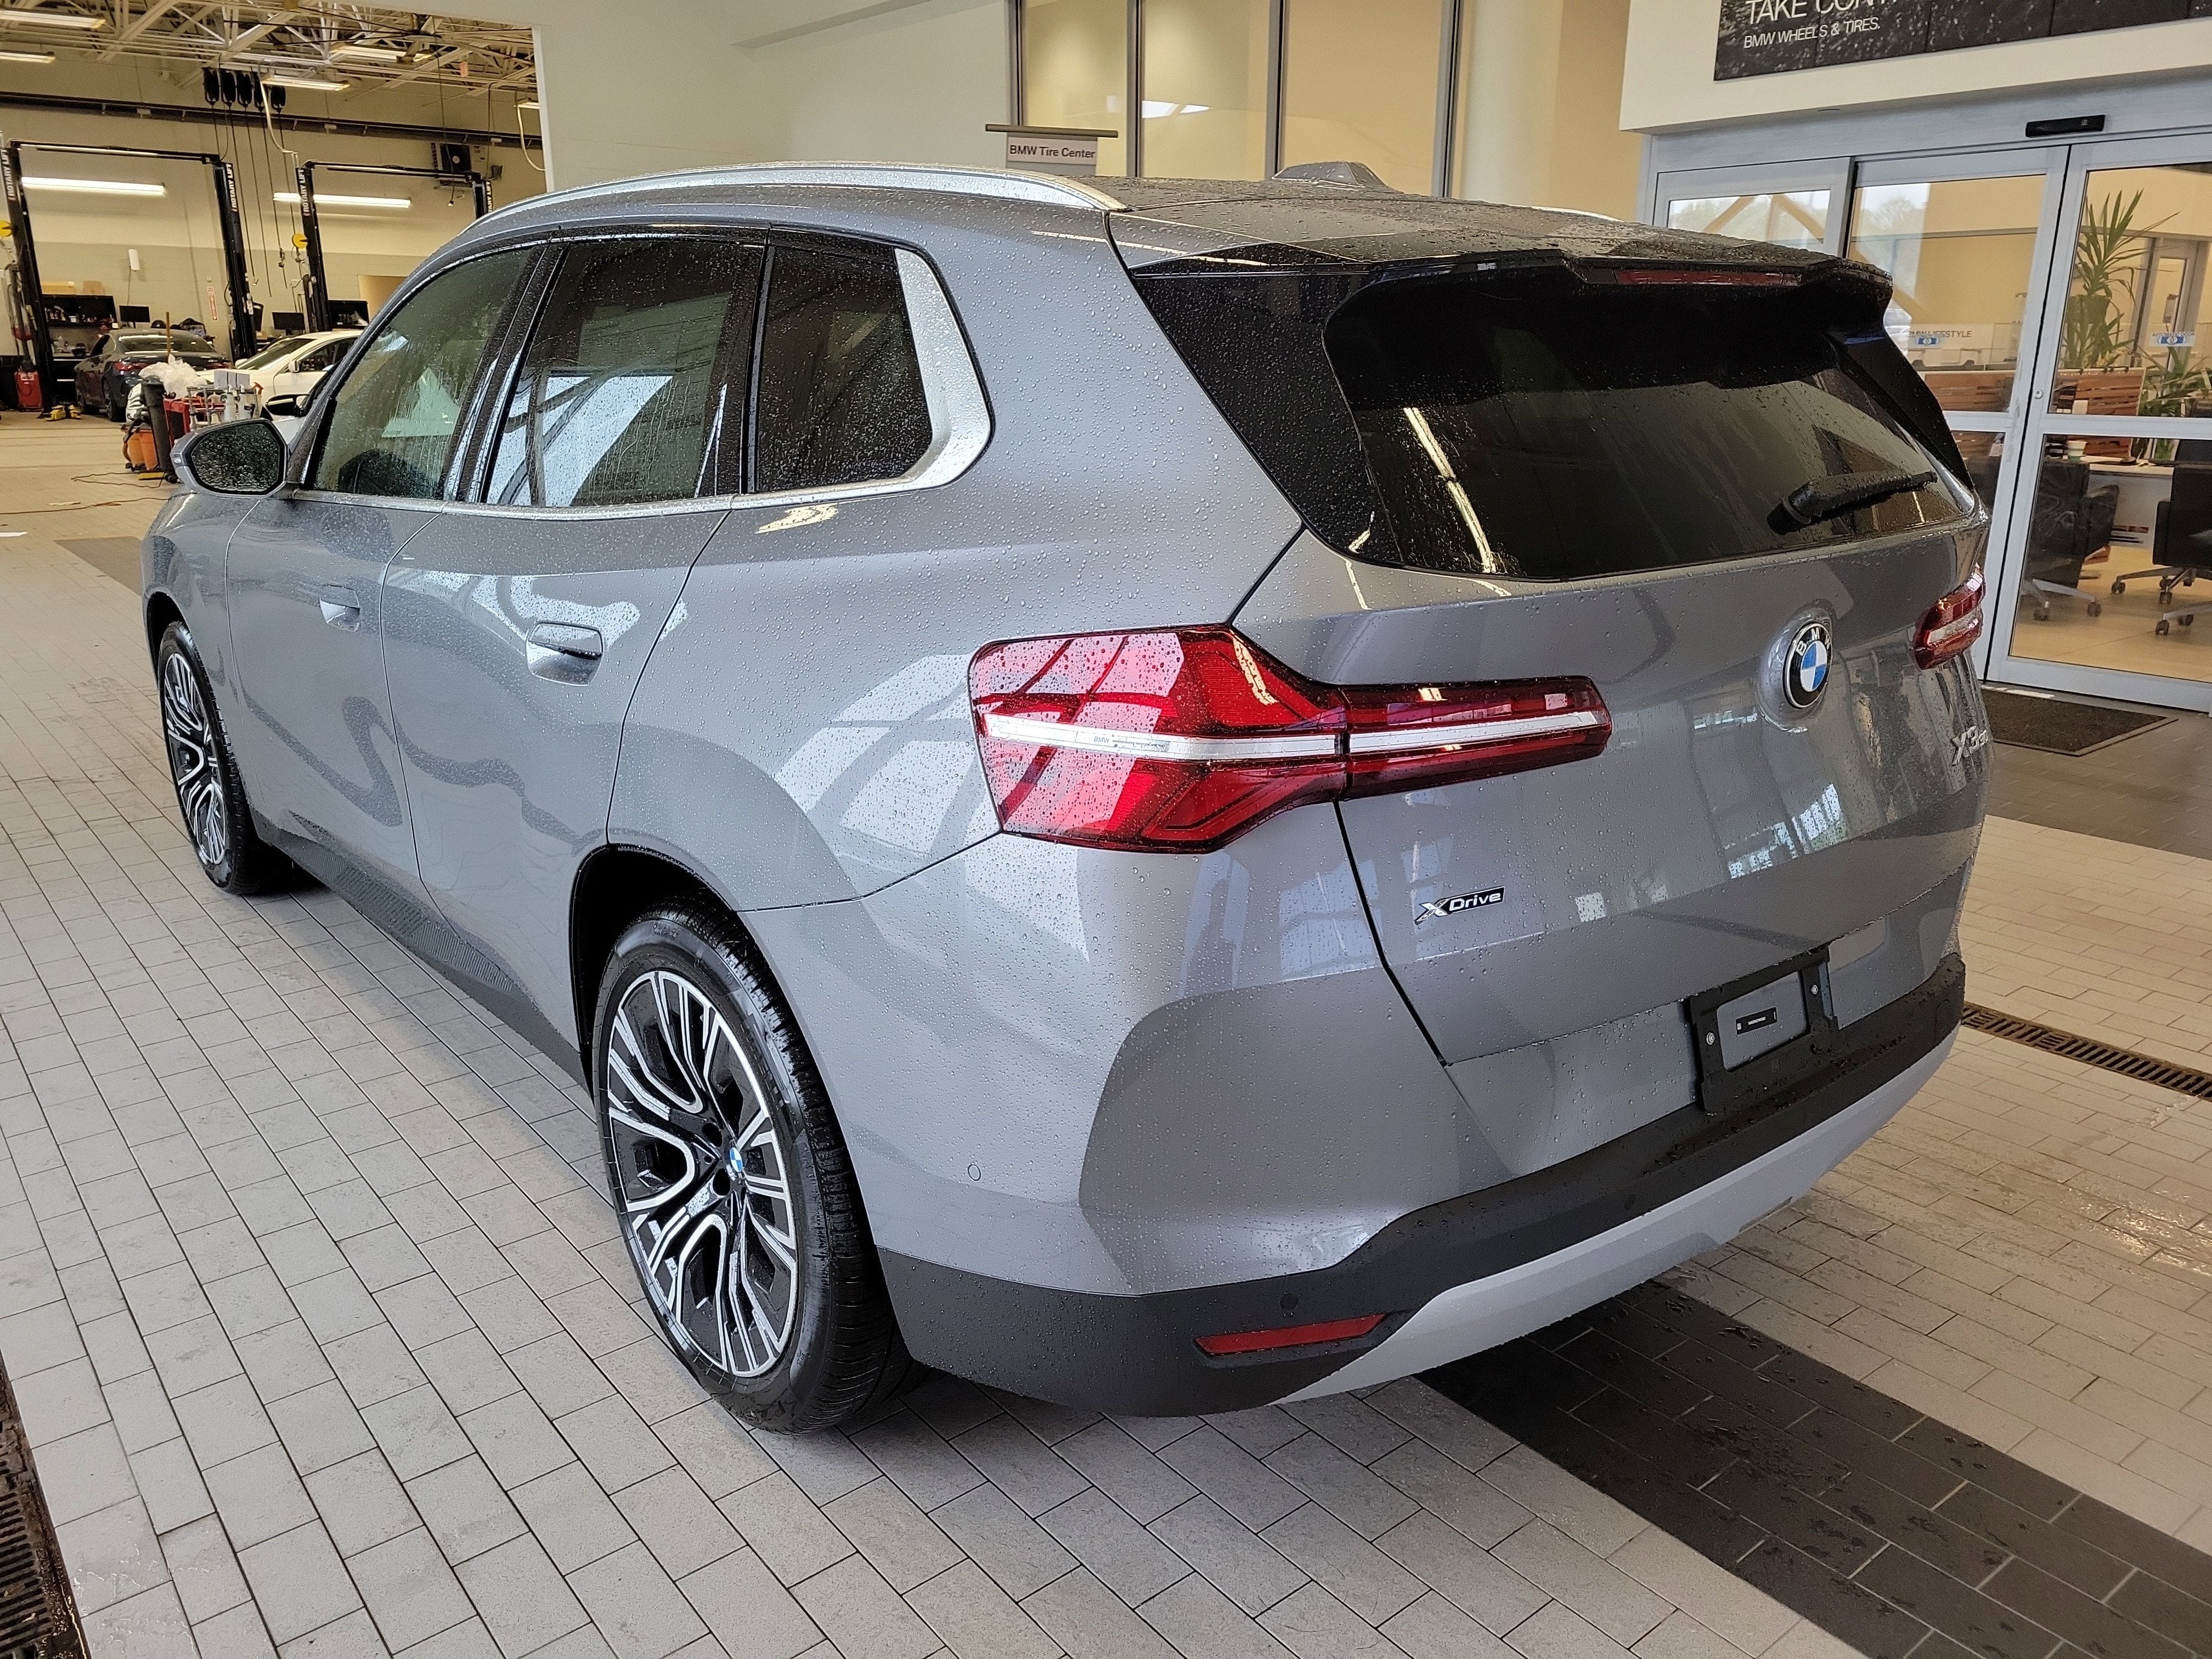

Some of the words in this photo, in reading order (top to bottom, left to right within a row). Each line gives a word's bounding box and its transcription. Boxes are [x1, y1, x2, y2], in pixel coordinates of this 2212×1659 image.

[1746, 0, 1807, 24] TAKE
[1744, 32, 1776, 48] BMW
[1778, 24, 1827, 43] WHEELS
[1830, 23, 1839, 36] &
[1843, 16, 1881, 34] TIRES.
[1, 149, 9, 164] LIFT
[1010, 145, 1037, 155] BMW
[1039, 146, 1059, 156] Tire
[1062, 148, 1096, 158] Center
[3, 166, 15, 196] ROTARY
[228, 179, 237, 208] ROTARY
[300, 184, 310, 212] ROTARY
[1796, 627, 1831, 657] BMW
